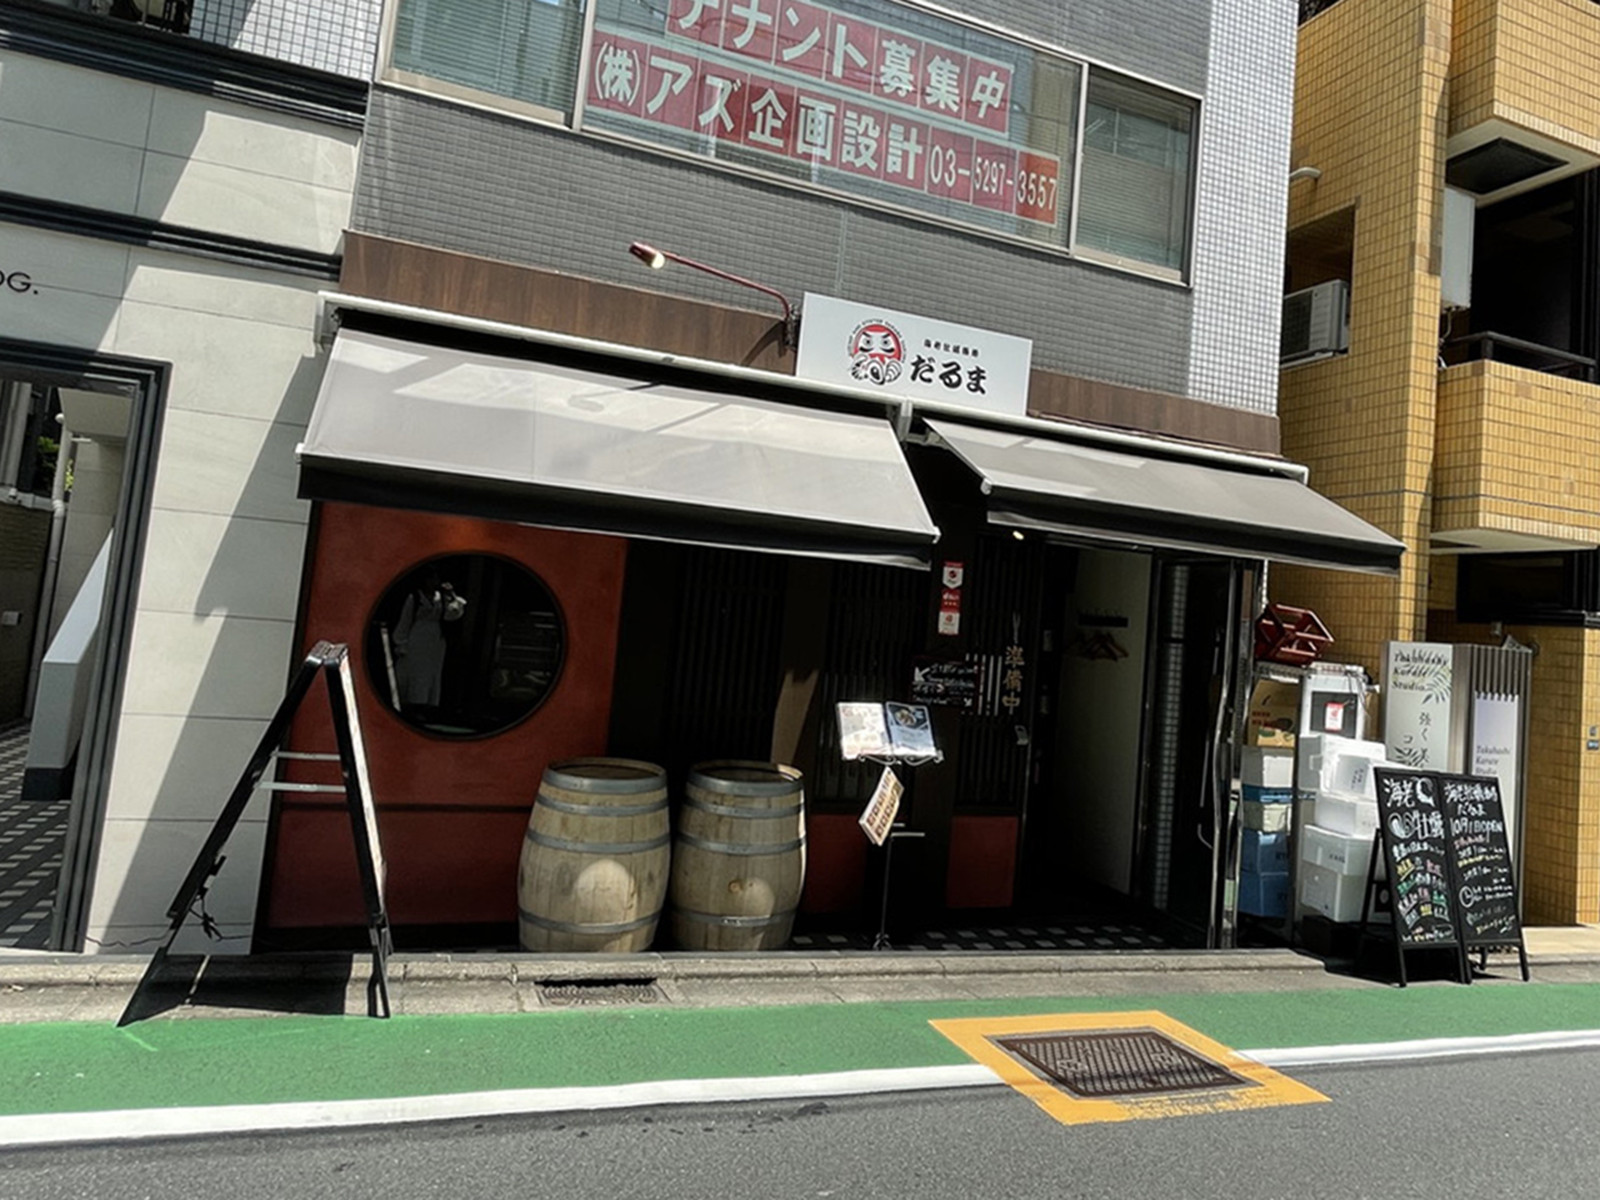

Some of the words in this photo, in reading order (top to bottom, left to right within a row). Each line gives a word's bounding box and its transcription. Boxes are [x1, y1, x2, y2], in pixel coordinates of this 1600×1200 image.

[677, 0, 1005, 120] テナント募集中
[0, 270, 38, 295] G.
[910, 354, 987, 395] だるま
[1002, 645, 1025, 716] 準備中
[1391, 681, 1426, 692] Studio
